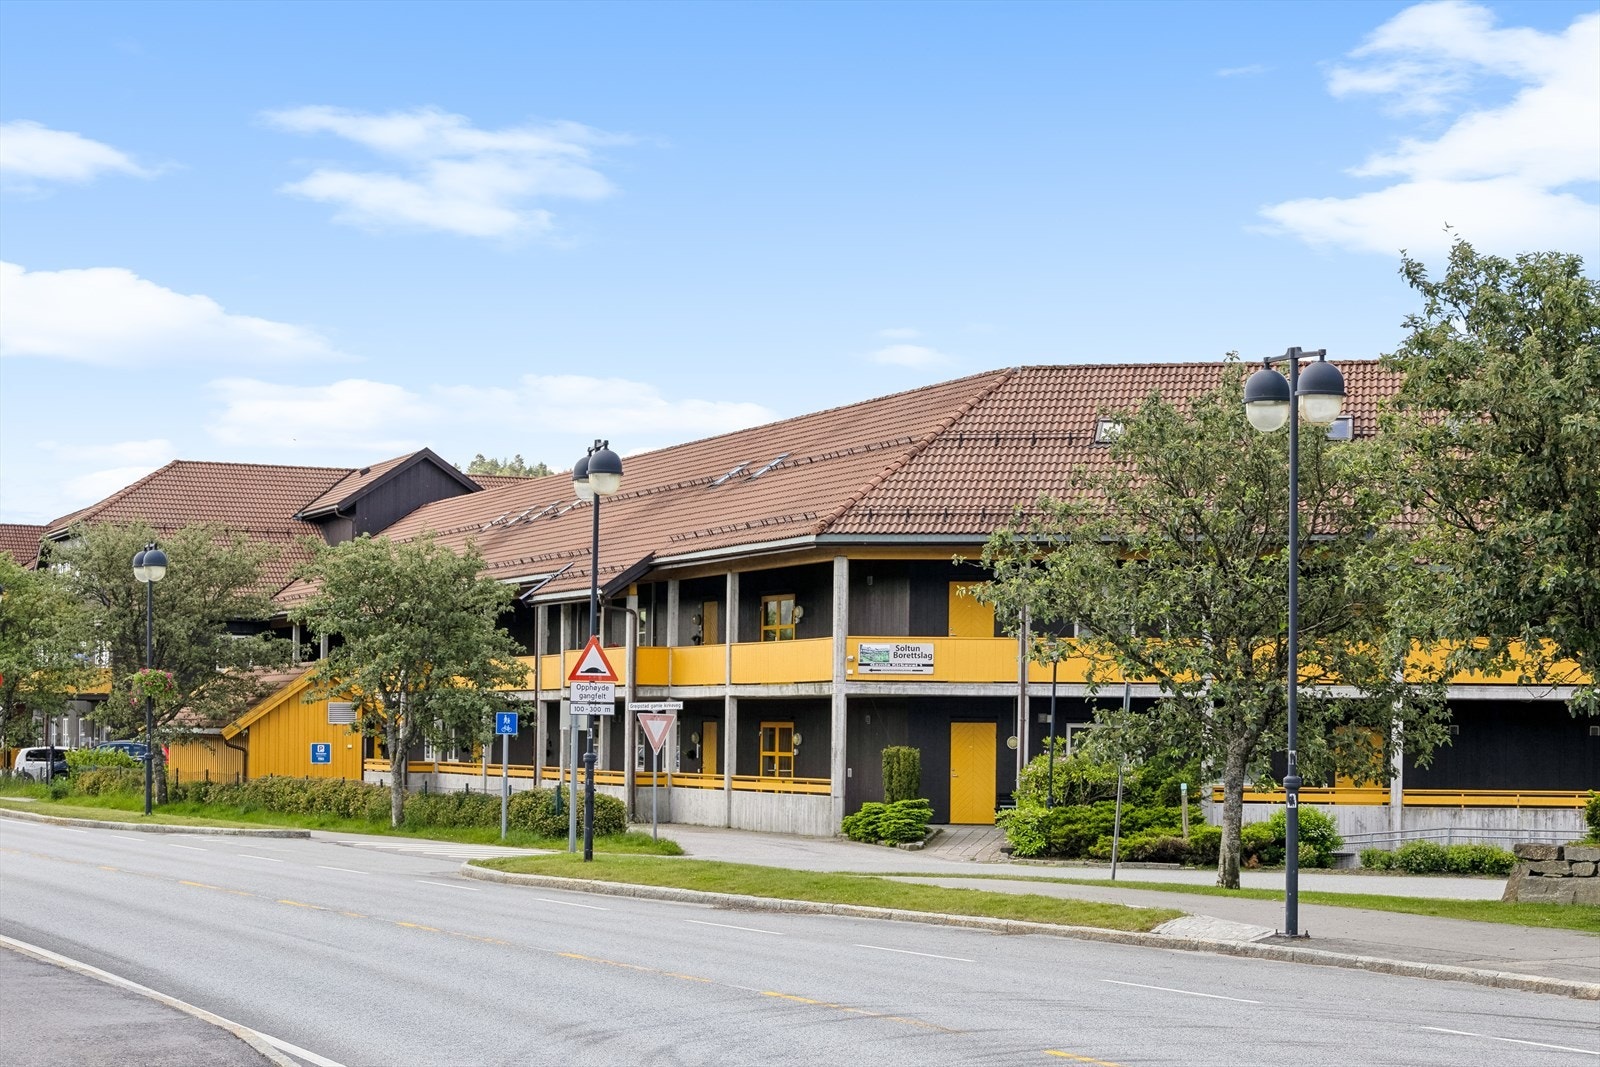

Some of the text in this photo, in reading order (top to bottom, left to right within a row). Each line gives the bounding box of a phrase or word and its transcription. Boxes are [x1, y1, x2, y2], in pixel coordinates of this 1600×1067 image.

[895, 644, 921, 652] Soltun
[893, 651, 933, 660] Borettslag
[576, 683, 610, 692] Opphøyde
